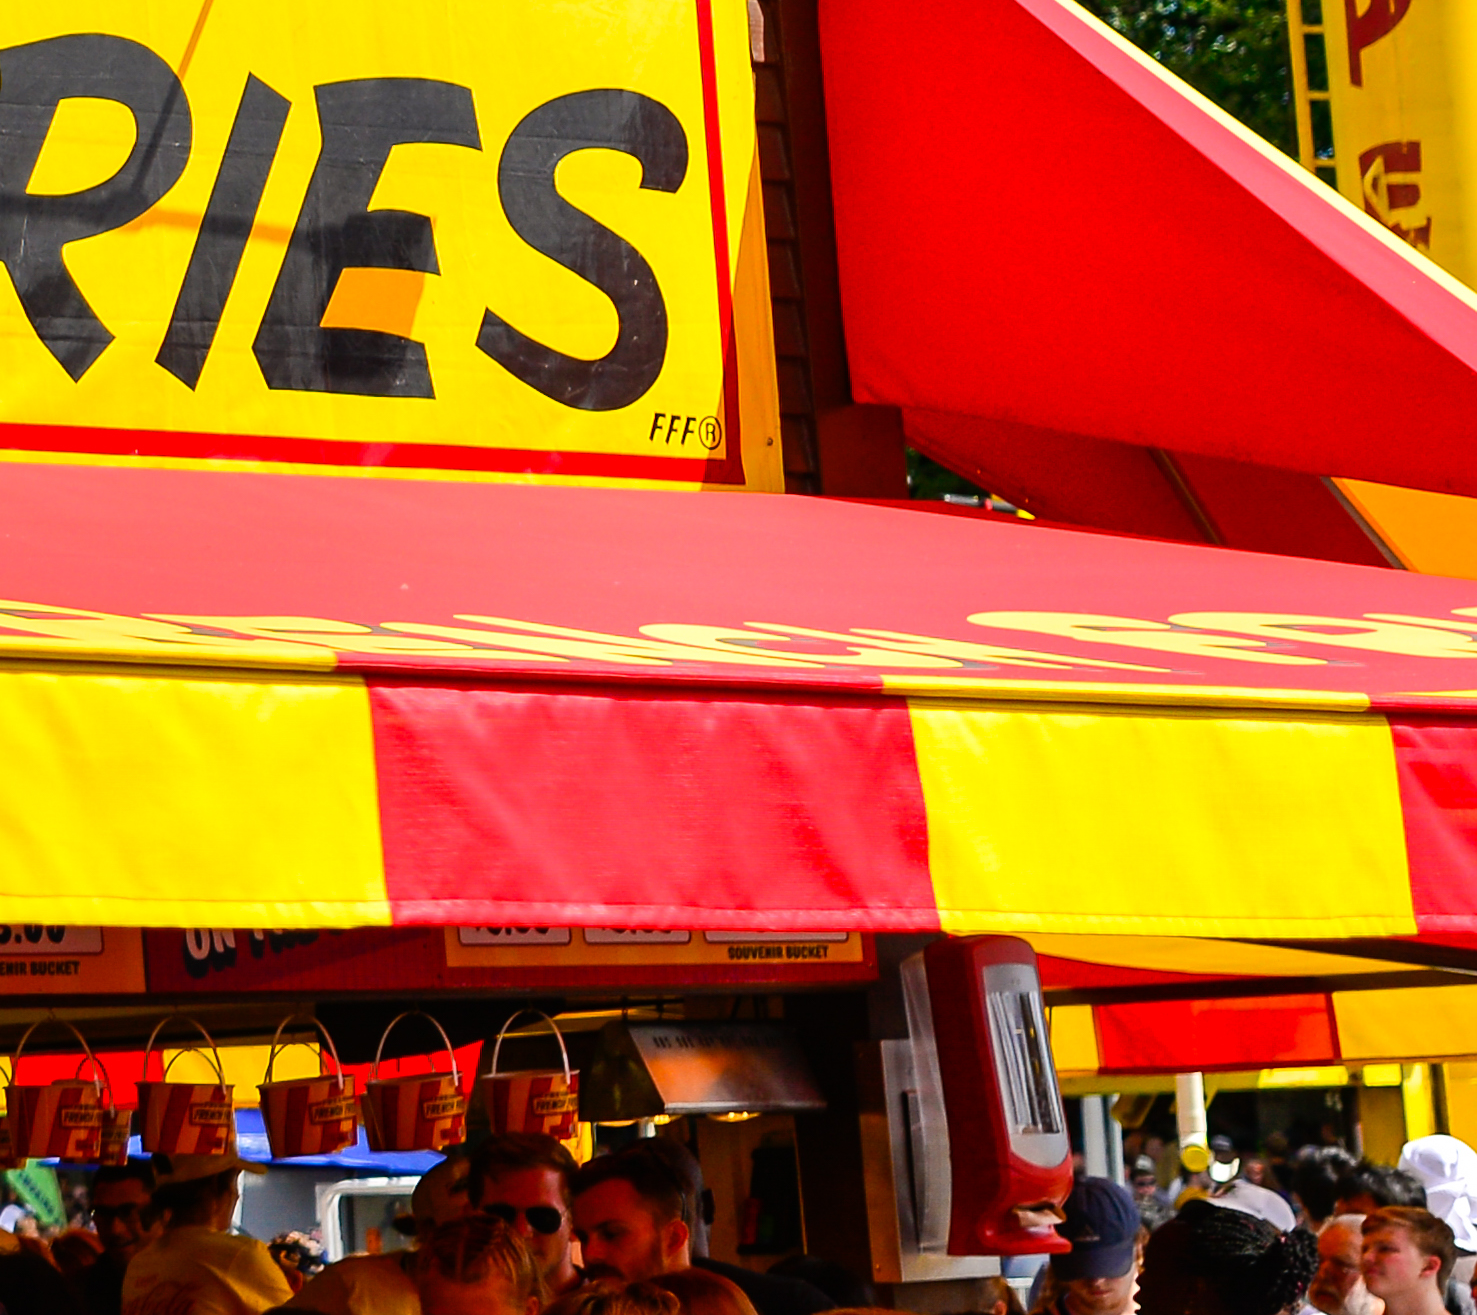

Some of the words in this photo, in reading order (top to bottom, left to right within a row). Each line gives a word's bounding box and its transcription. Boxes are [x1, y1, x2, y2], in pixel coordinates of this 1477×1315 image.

[728, 945, 783, 960] SOUVENIR
[786, 944, 829, 959] BUCKET
[30, 959, 80, 976] BUCKET
